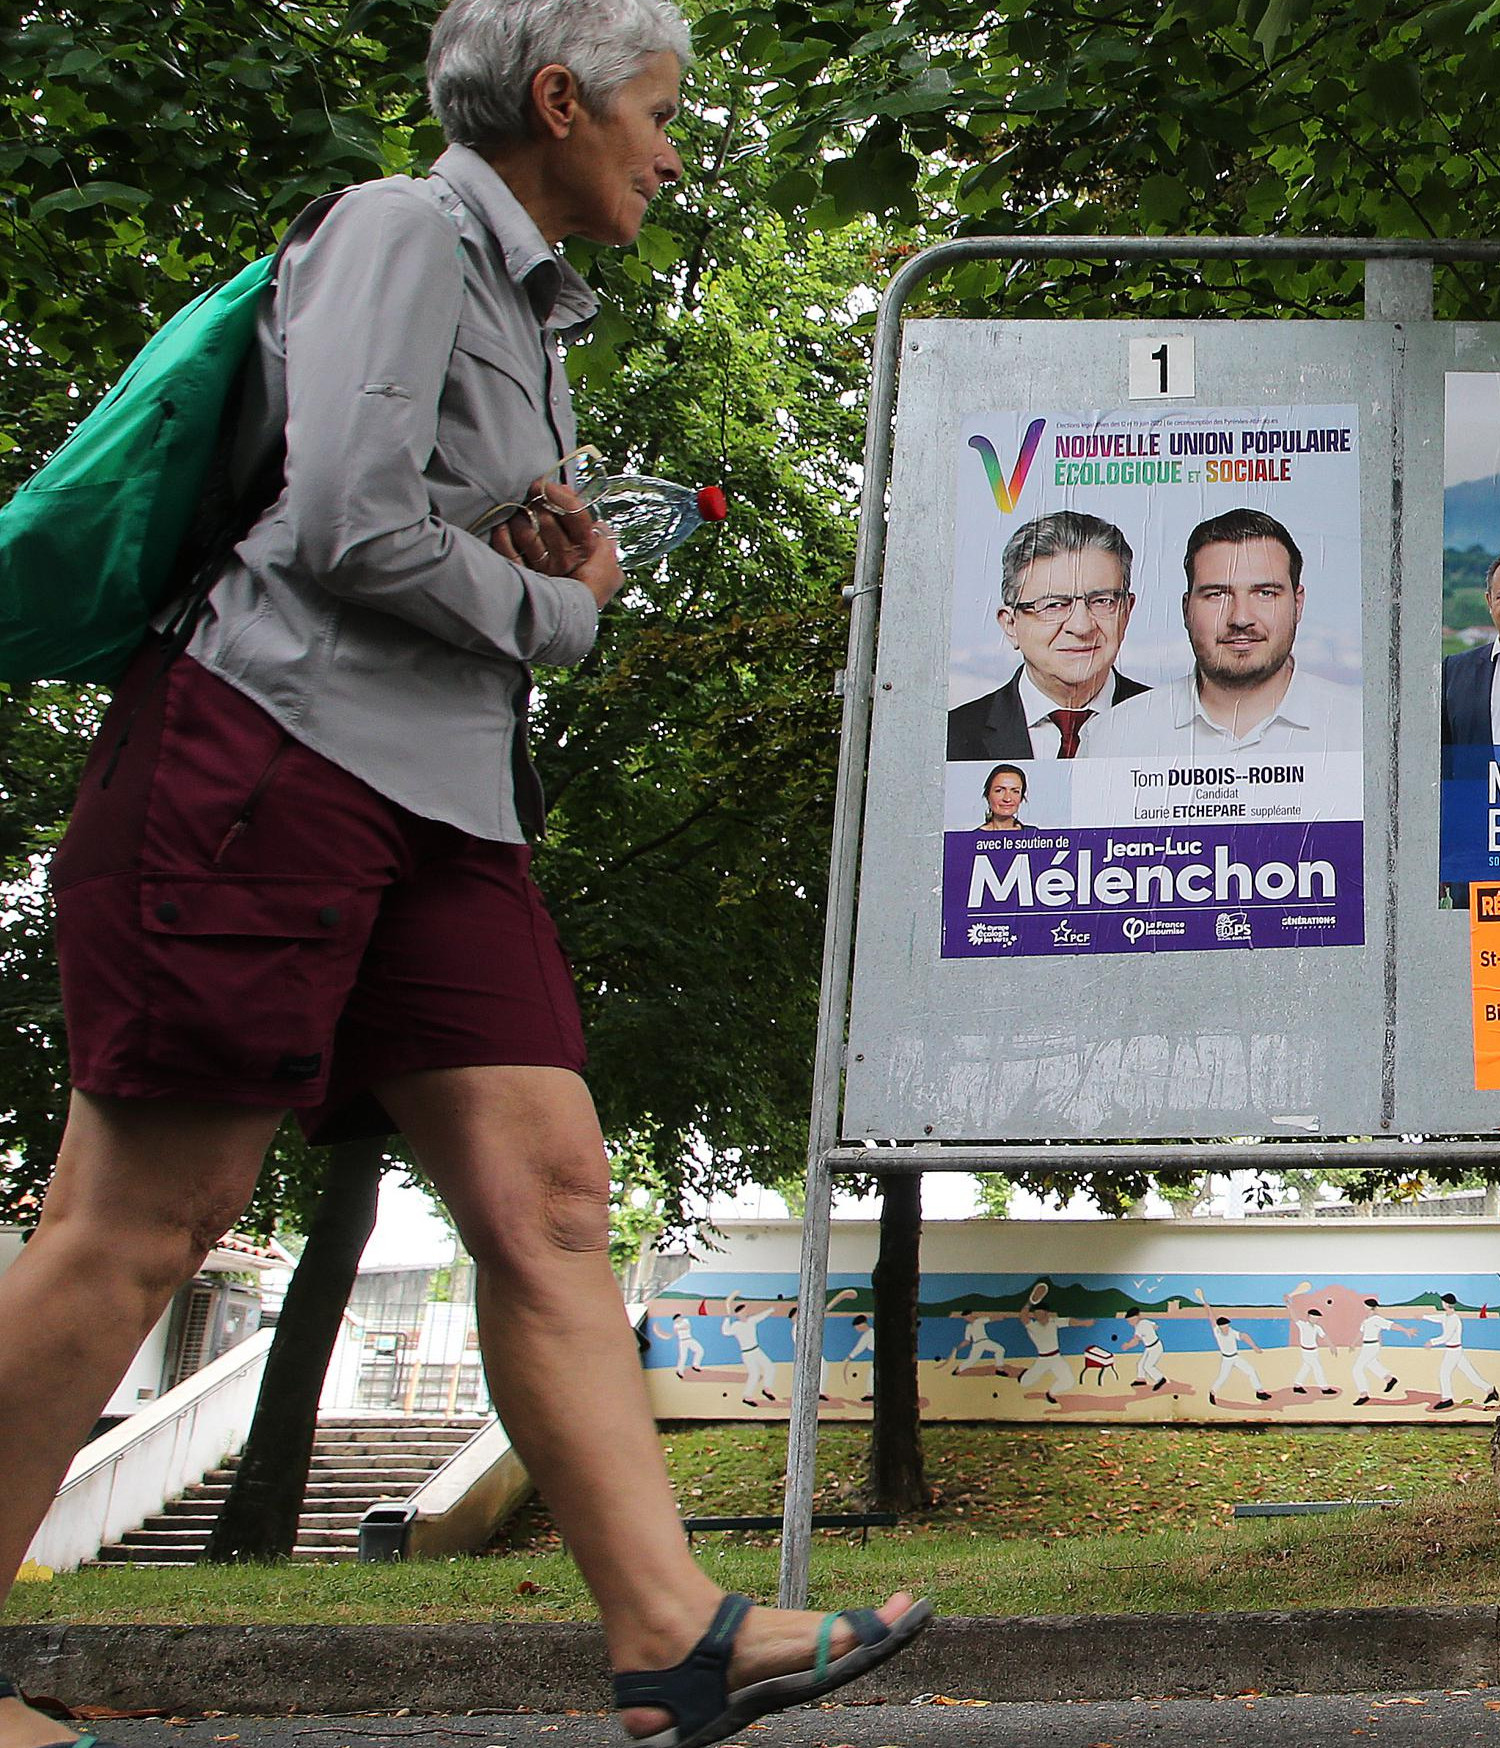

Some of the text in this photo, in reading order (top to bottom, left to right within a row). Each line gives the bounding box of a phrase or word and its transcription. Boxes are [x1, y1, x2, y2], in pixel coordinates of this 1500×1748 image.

[1151, 344, 1169, 394] 1
[1055, 428, 1351, 458] NOUVELLE UNION POPULAIRE
[1055, 458, 1291, 486] ÉCOLOGIQUE ET SOCIALE
[1131, 766, 1304, 789] Tom DUBOIS--ROBIN
[1196, 787, 1239, 799] Candidat
[1134, 803, 1301, 820] Laurie ETCHEPARE suppléante
[976, 837, 1069, 850] avec le soutien de
[1103, 837, 1203, 863] Jean-Luc
[966, 845, 1336, 908] Mélenchon
[1145, 920, 1185, 929] La France
[1234, 923, 1252, 936] PS
[1070, 933, 1090, 943] PCF
